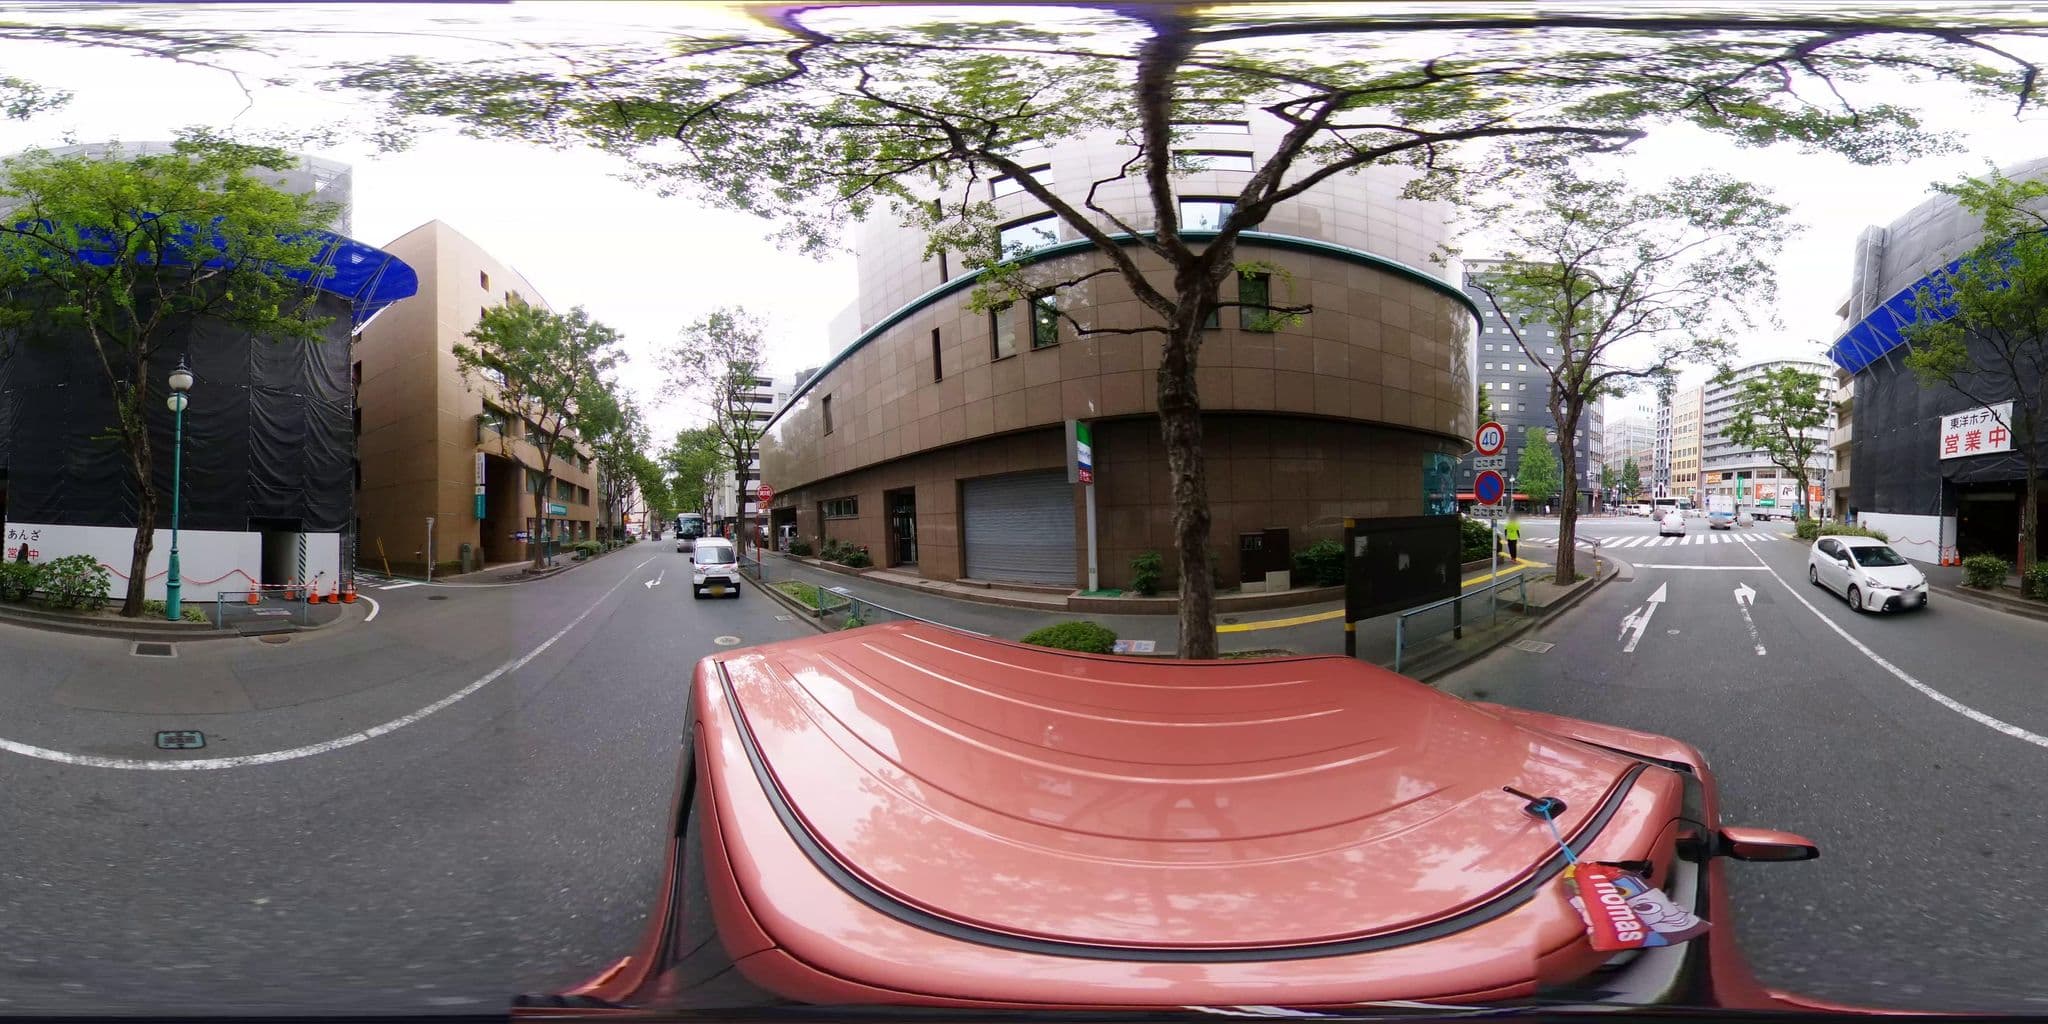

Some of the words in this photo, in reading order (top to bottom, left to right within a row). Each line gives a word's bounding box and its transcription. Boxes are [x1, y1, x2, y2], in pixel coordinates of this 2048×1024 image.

[1950, 409, 2001, 430] 東洋ホテル
[1482, 431, 1498, 446] 40
[1945, 425, 2006, 455] 営業中
[1475, 458, 1503, 468] ここまで
[1473, 508, 1503, 517] ここまで
[7, 547, 39, 560] 営中
